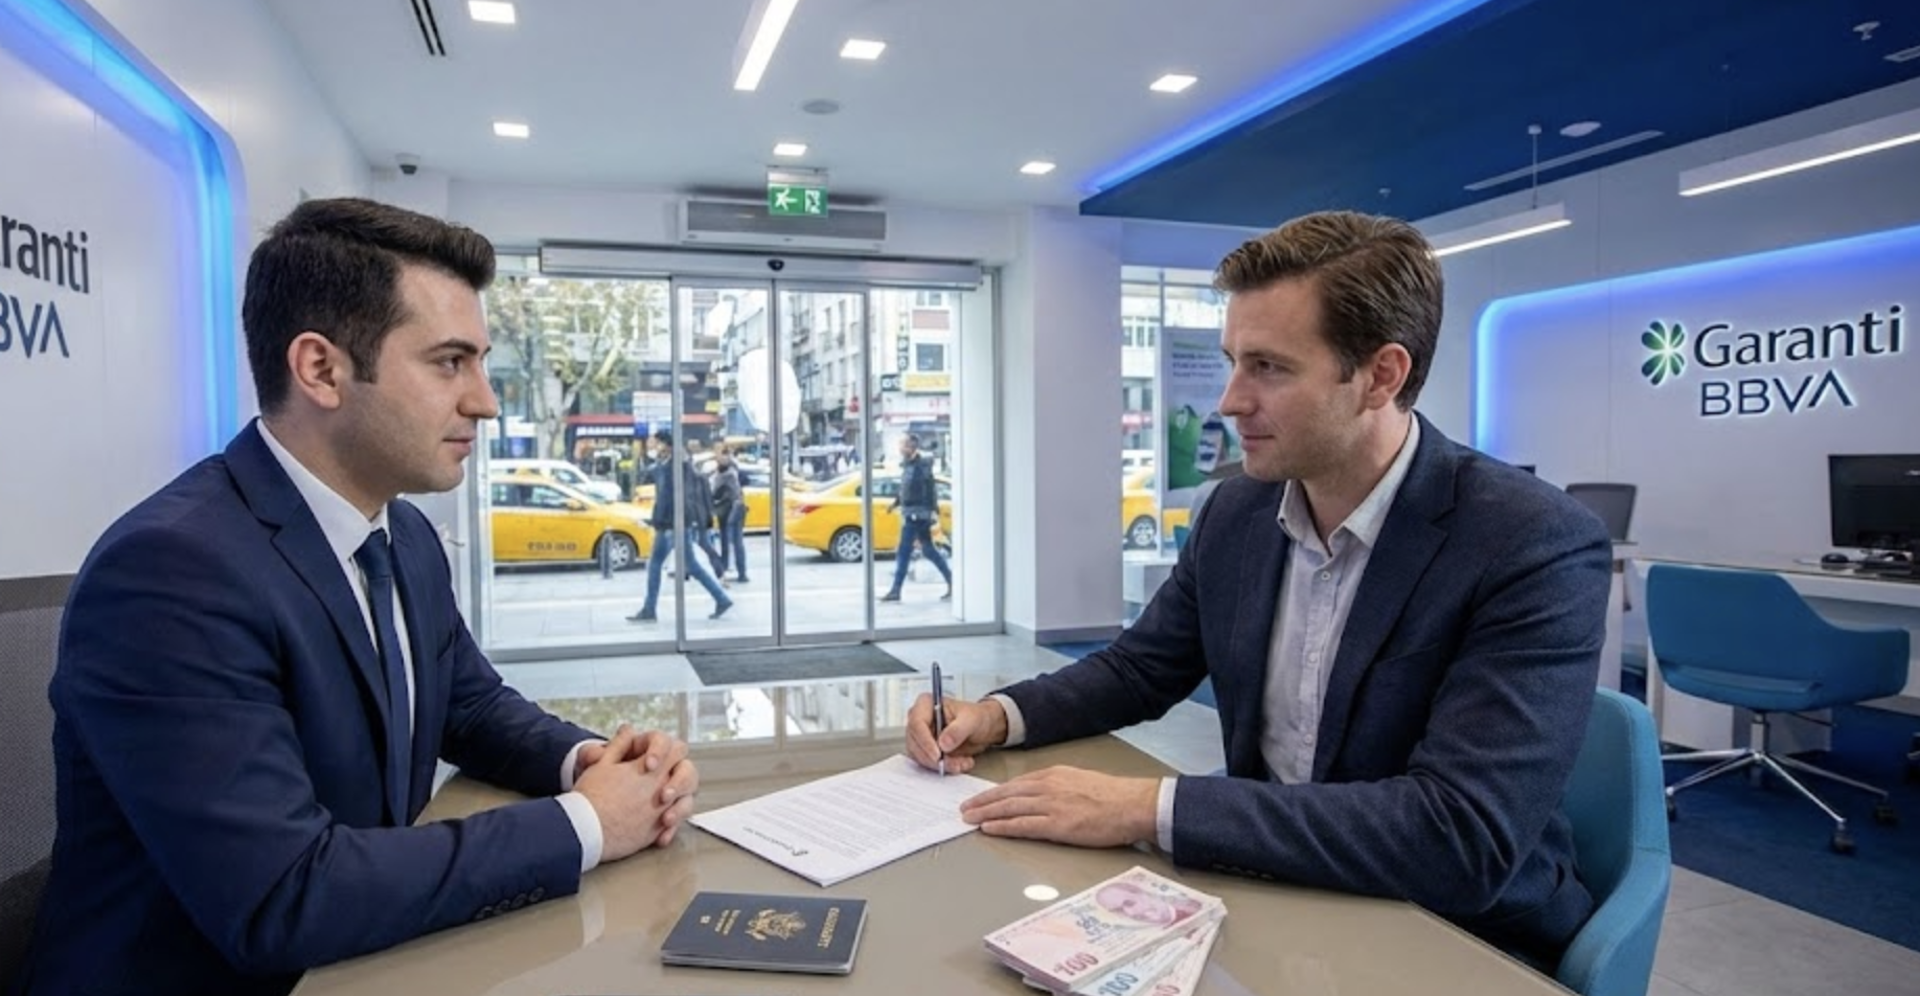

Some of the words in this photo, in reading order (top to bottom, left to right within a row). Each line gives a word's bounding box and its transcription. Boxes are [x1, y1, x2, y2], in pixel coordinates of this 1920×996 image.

[0, 215, 90, 294] ranti
[1694, 304, 1902, 368] Garanti
[1700, 369, 1854, 417] BBVA
